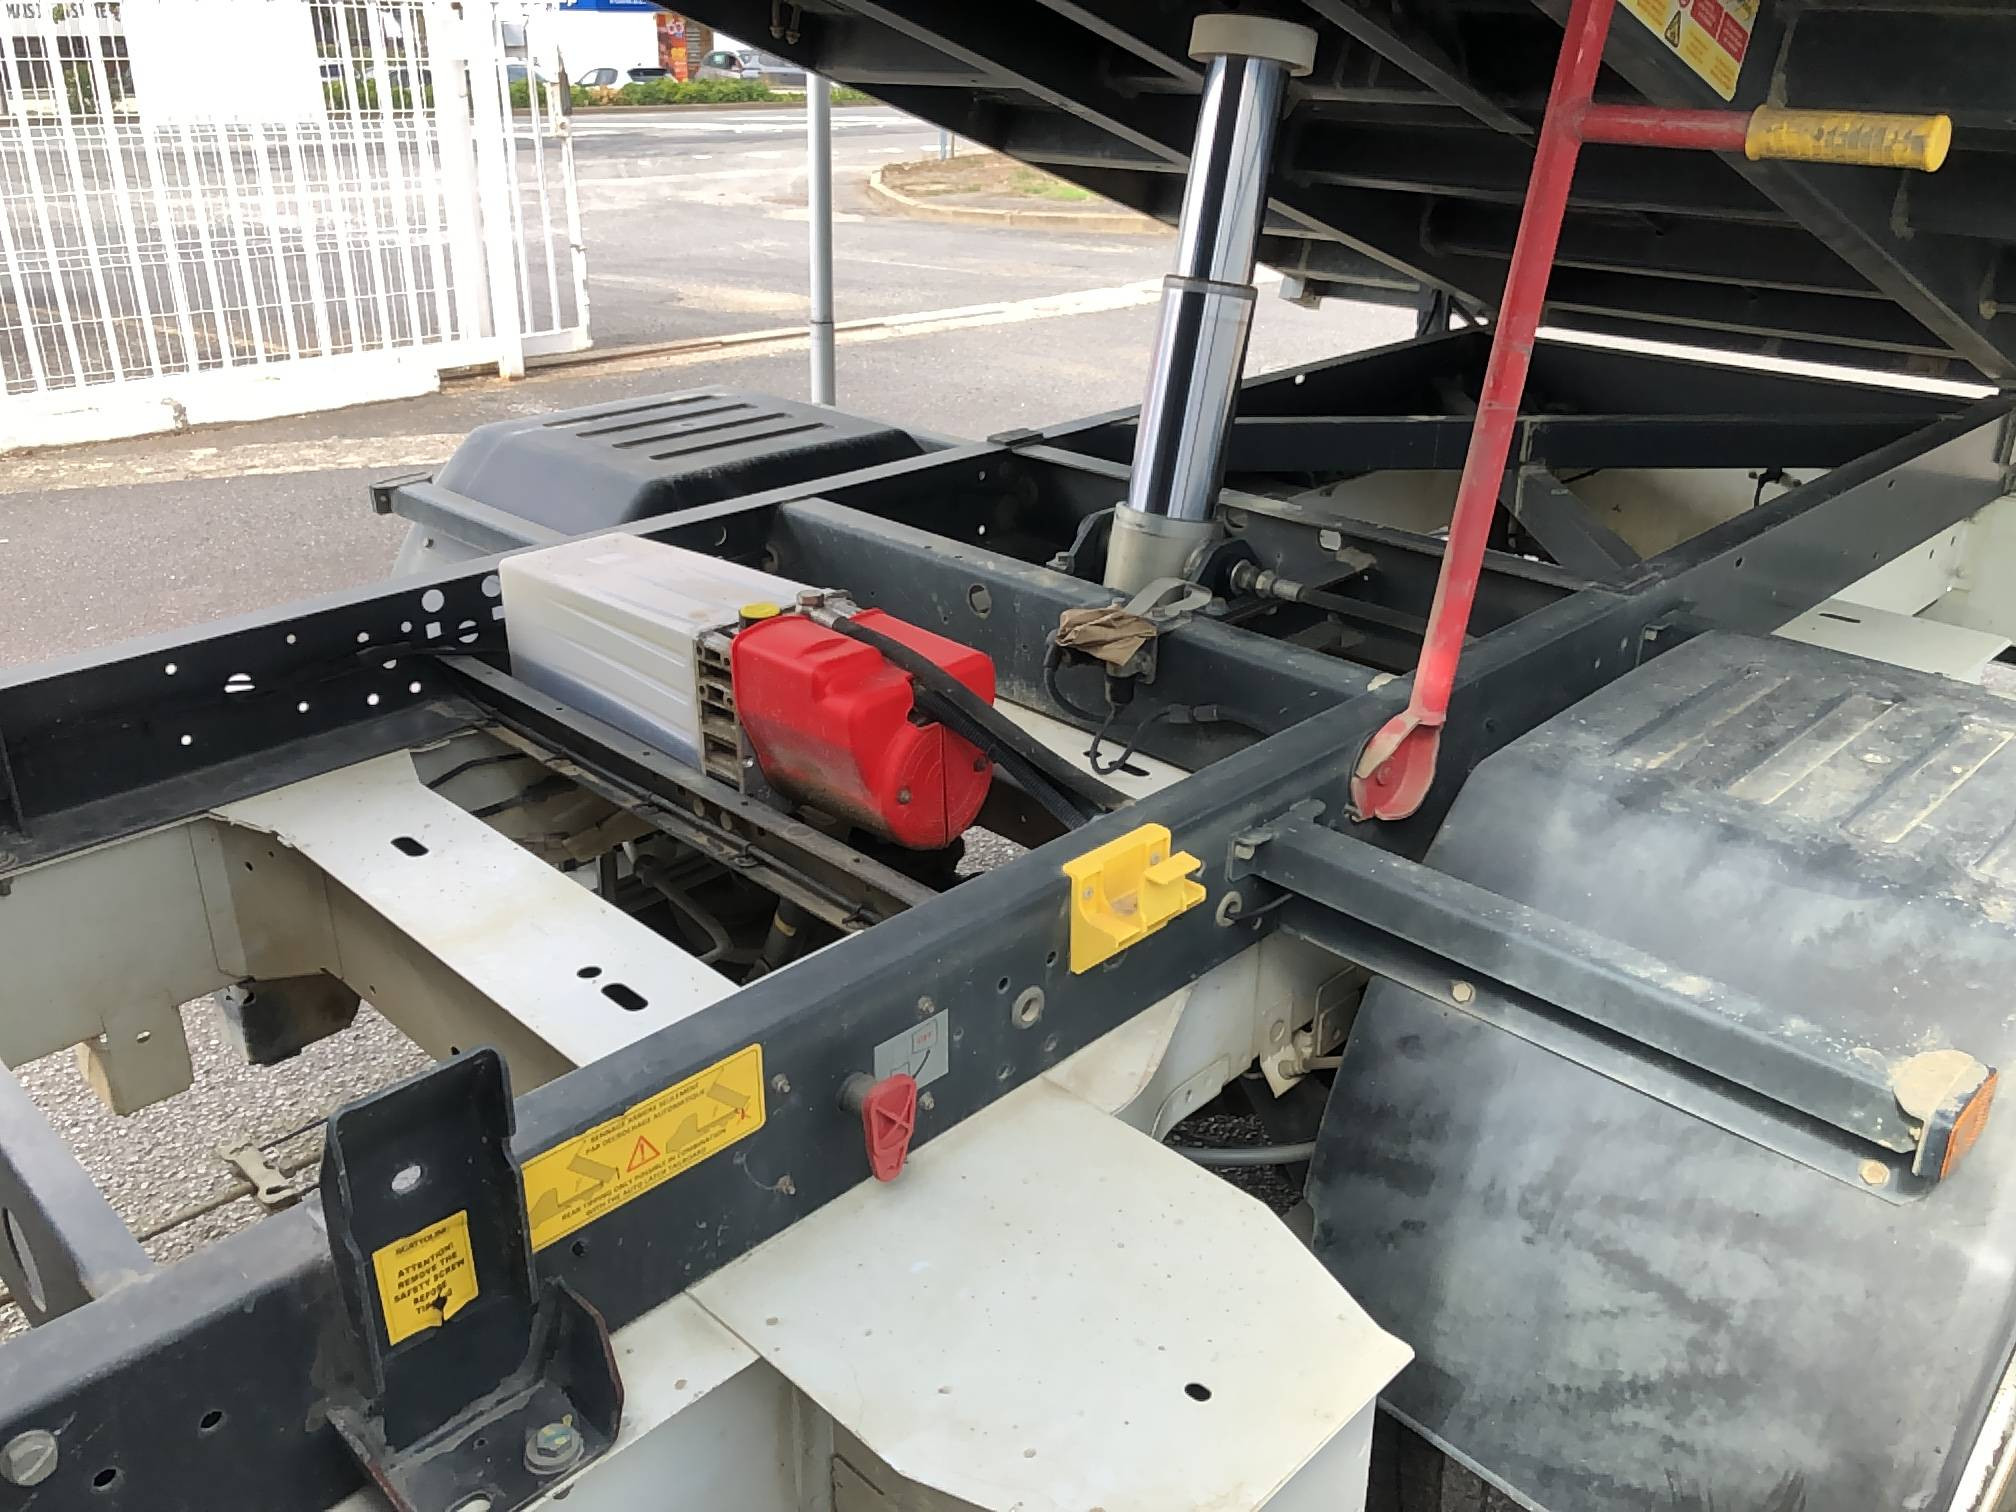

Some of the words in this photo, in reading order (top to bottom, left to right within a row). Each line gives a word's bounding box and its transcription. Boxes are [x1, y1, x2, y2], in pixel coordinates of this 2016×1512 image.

[585, 1141, 601, 1155] PAR
[561, 1205, 581, 1221] REAR
[582, 1188, 611, 1209] TIPPING
[613, 1177, 632, 1193] ONLY
[634, 1159, 665, 1182] POSSIBLE
[667, 1153, 676, 1164] IN
[677, 1126, 726, 1158] COMBINATION
[585, 1200, 606, 1216] WITH
[607, 1191, 621, 1204] THE
[622, 1180, 642, 1196] AUTO
[644, 1167, 666, 1184] LATCH
[394, 1278, 430, 1303] SAFETY
[433, 1257, 464, 1282] SCREW
[398, 1264, 437, 1289] REMOVE
[440, 1251, 457, 1265] THE
[413, 1280, 446, 1304] BEFORE
